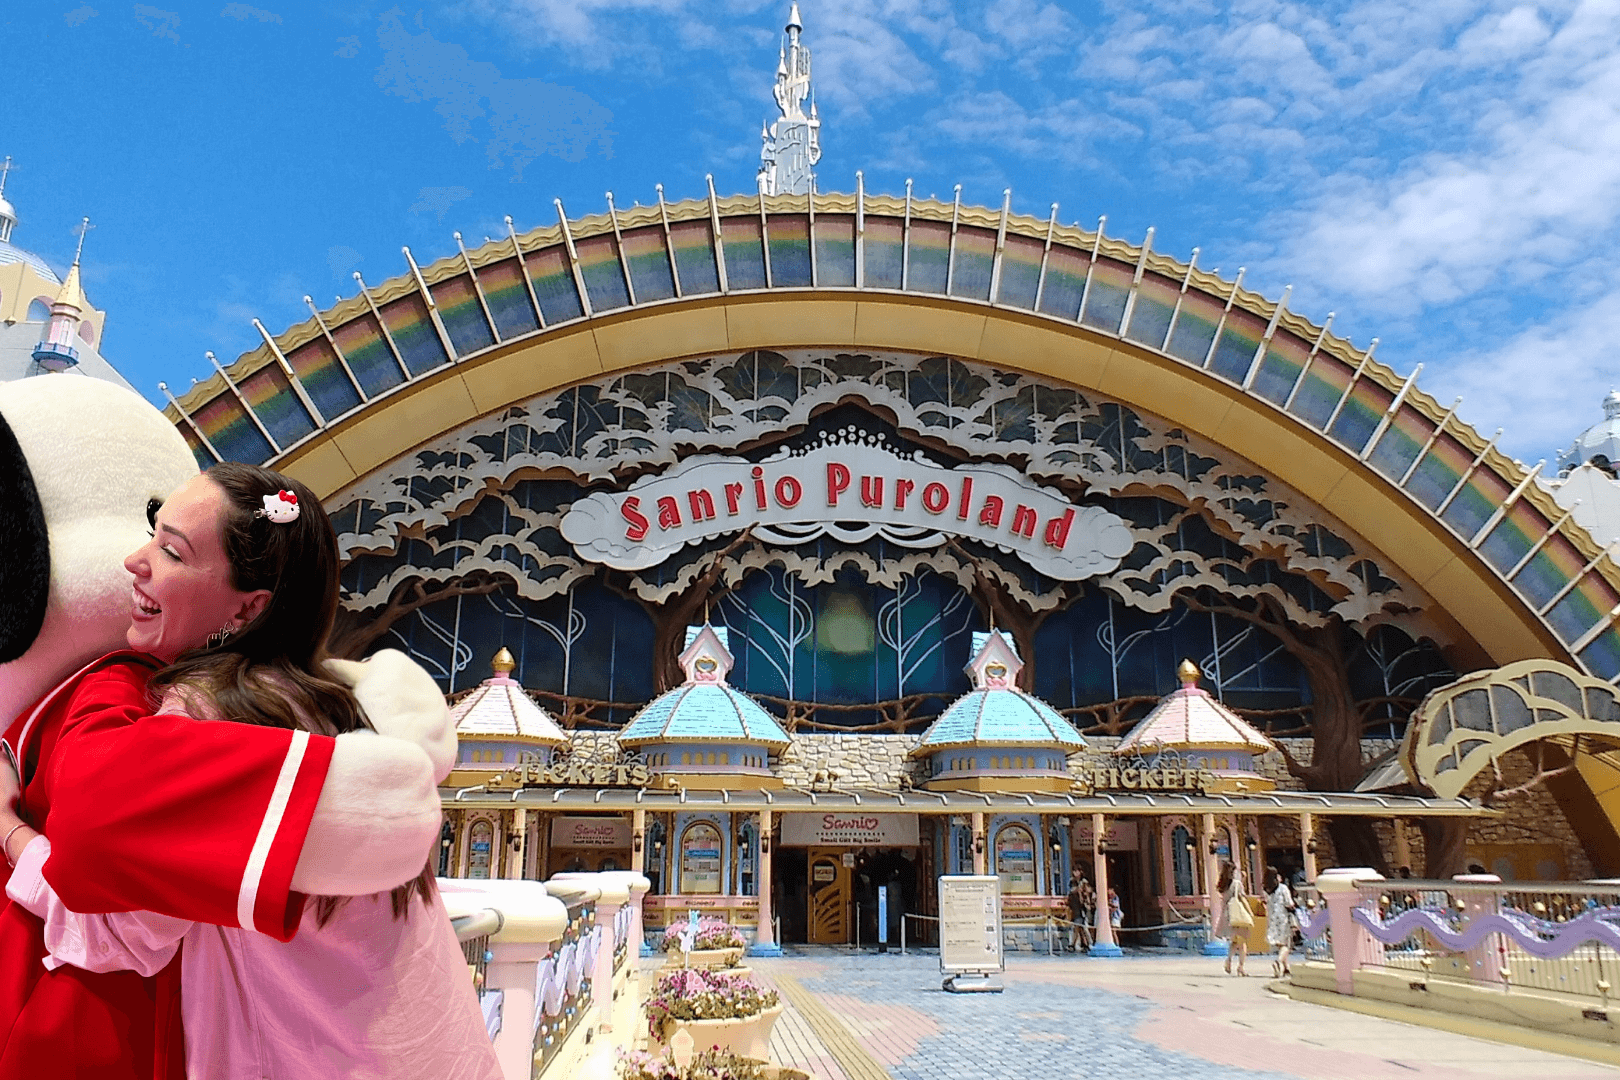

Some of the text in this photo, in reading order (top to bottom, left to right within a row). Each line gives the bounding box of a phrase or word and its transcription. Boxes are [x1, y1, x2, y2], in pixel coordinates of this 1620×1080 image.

[620, 461, 1077, 550] Sanrio Puroland
[519, 763, 649, 785] TICKETS
[1091, 768, 1215, 789] TICKETS
